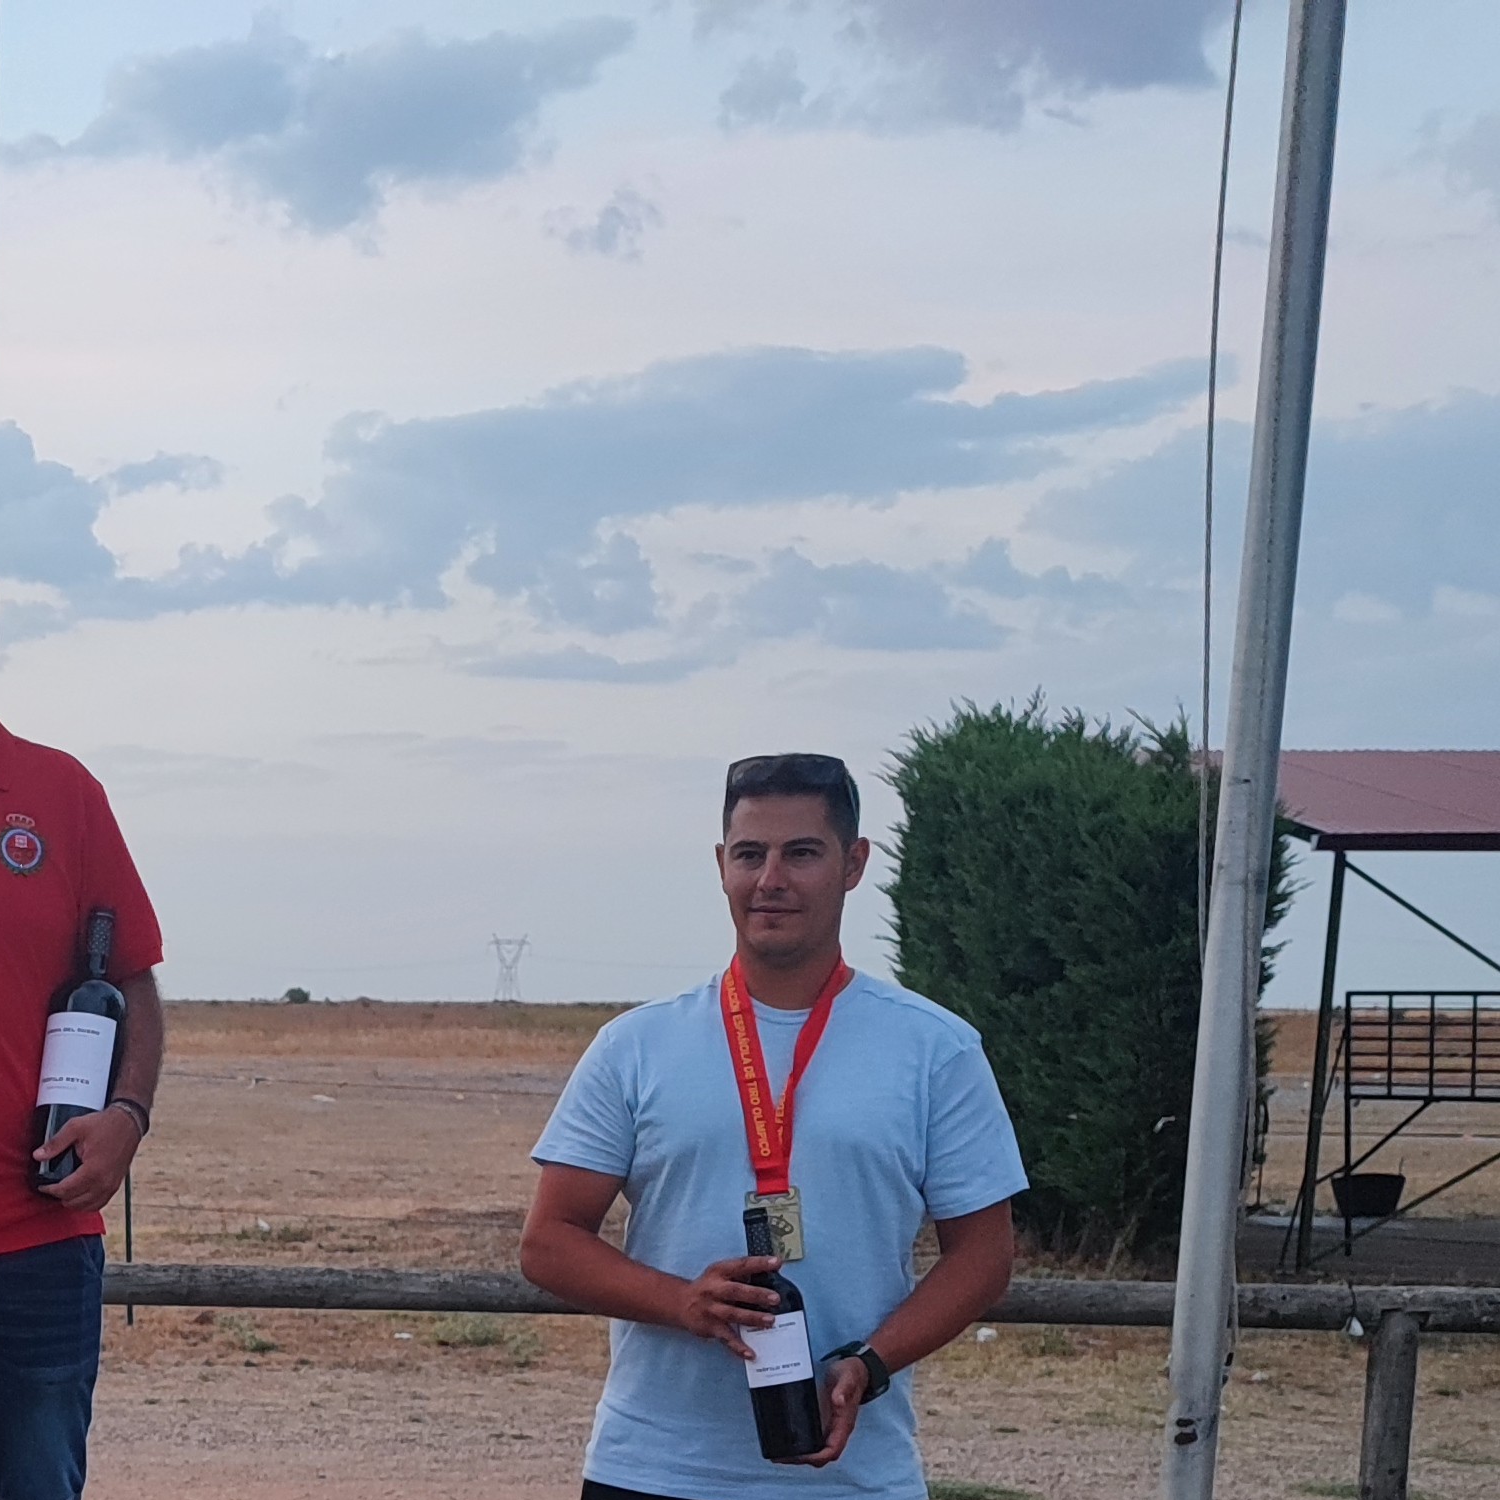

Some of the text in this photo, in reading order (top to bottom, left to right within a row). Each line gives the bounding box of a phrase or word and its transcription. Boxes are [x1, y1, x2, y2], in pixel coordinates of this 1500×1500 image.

[733, 1013, 753, 1064] ESPAÑOLA
[743, 1065, 755, 1080] DE
[747, 1080, 760, 1105] TIRO
[752, 1106, 771, 1157] OLÍMPICO
